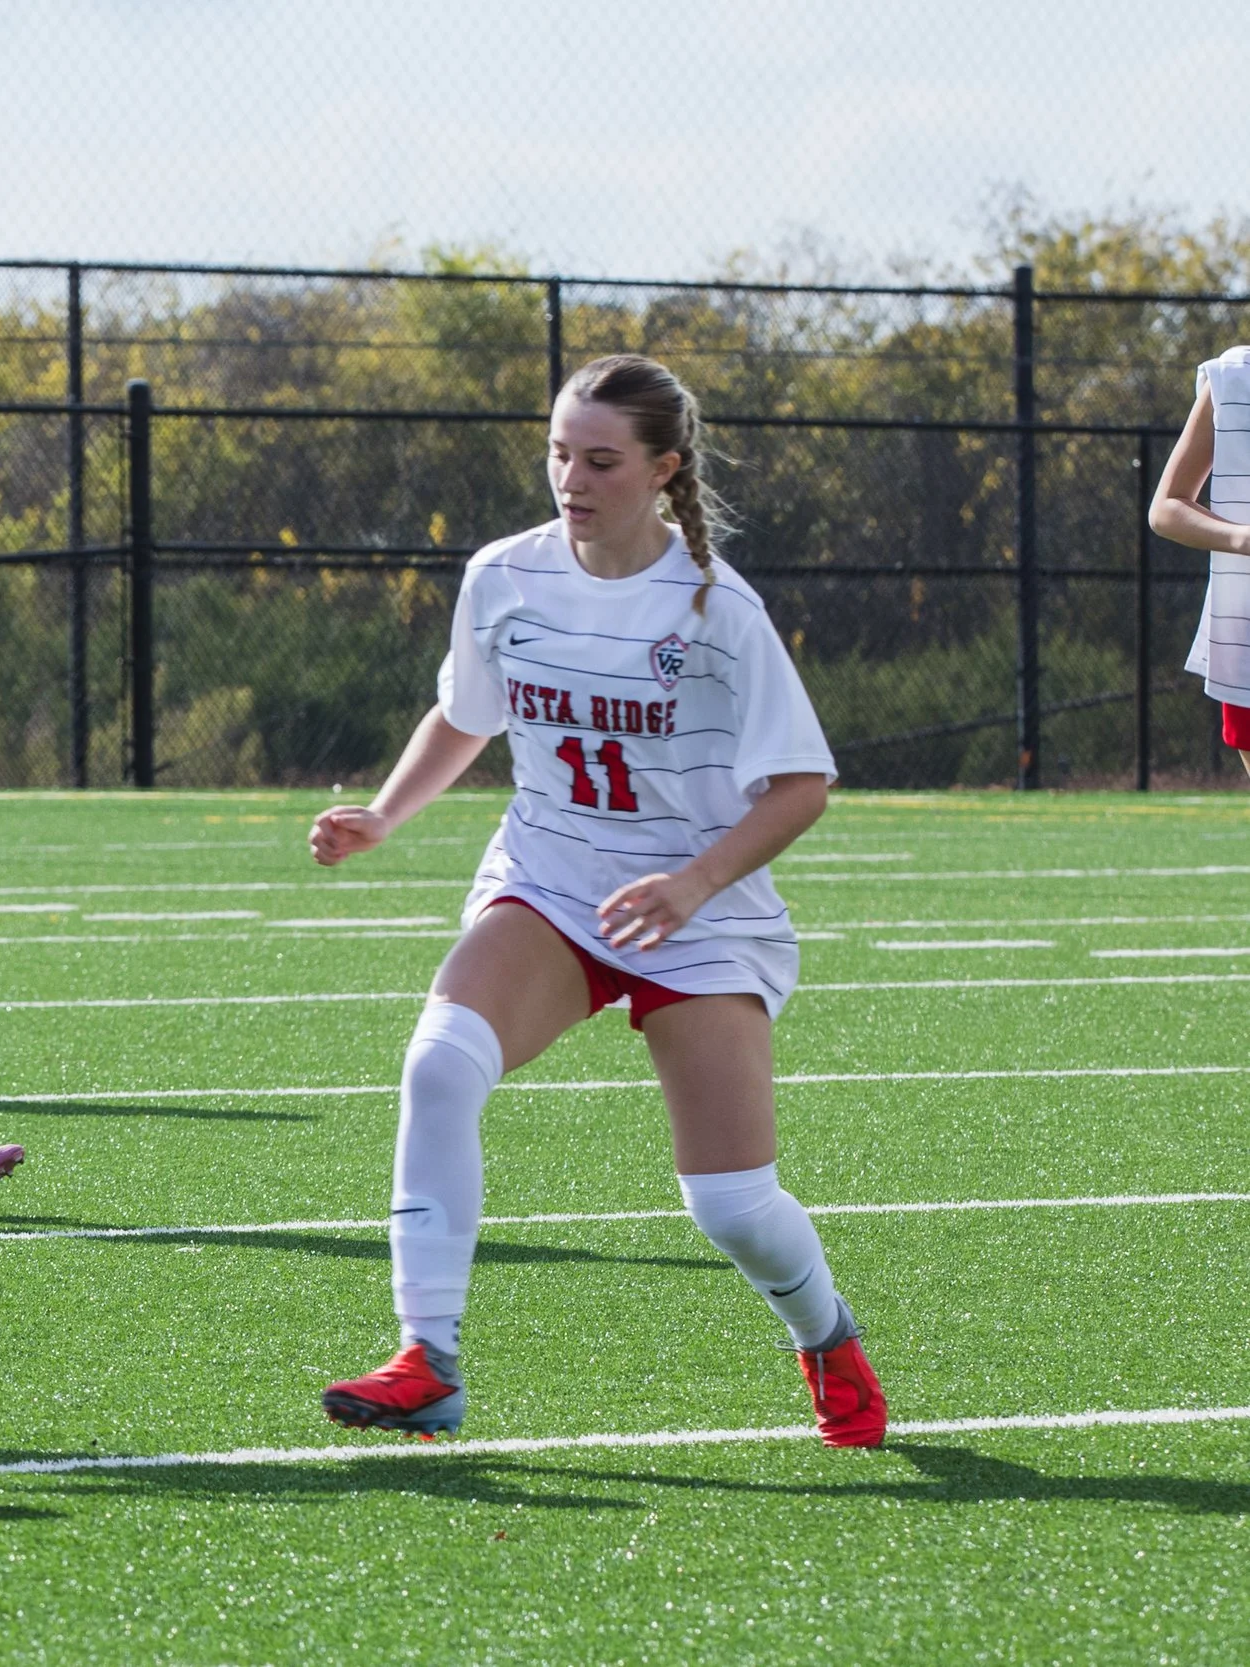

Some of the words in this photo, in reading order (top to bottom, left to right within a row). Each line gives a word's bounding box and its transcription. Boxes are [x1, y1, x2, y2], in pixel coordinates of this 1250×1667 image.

[657, 653, 684, 676] VR
[590, 695, 678, 737] RIDGE
[556, 736, 639, 813] 11
